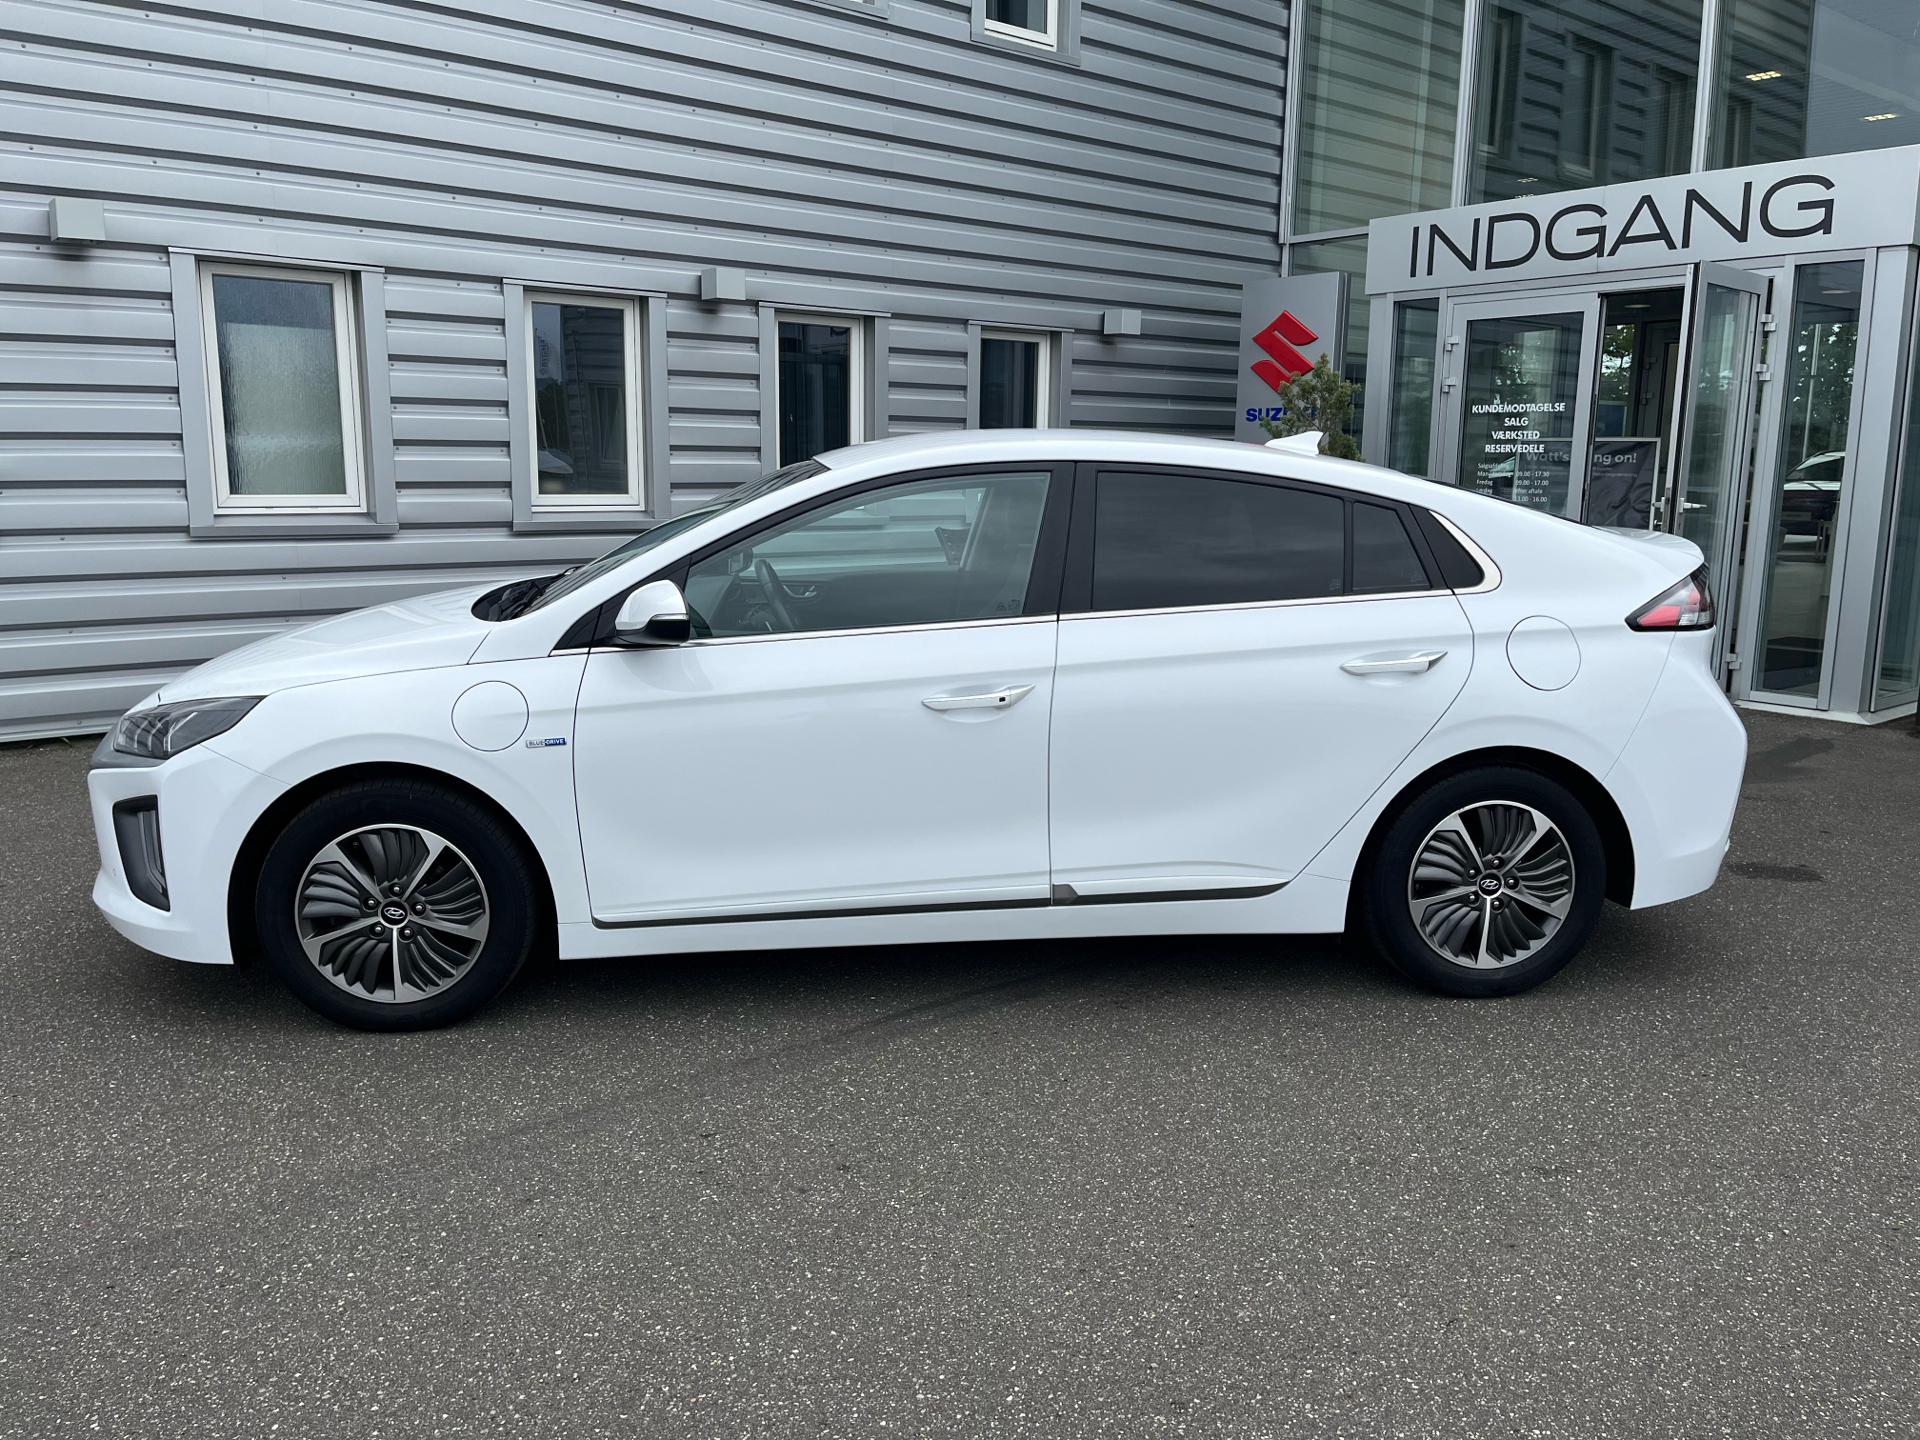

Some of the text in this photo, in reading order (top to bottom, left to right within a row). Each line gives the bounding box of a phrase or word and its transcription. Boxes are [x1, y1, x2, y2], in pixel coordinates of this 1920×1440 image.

[1410, 174, 1836, 278] INDGANG
[1472, 403, 1565, 413] KUNDEMODTAGELSE
[1504, 417, 1529, 426] SALG
[1492, 431, 1540, 440] VÆRKSTED
[1485, 444, 1545, 453] RESERVEDELE
[1526, 451, 1569, 462] Watt's
[1614, 453, 1637, 463] on!
